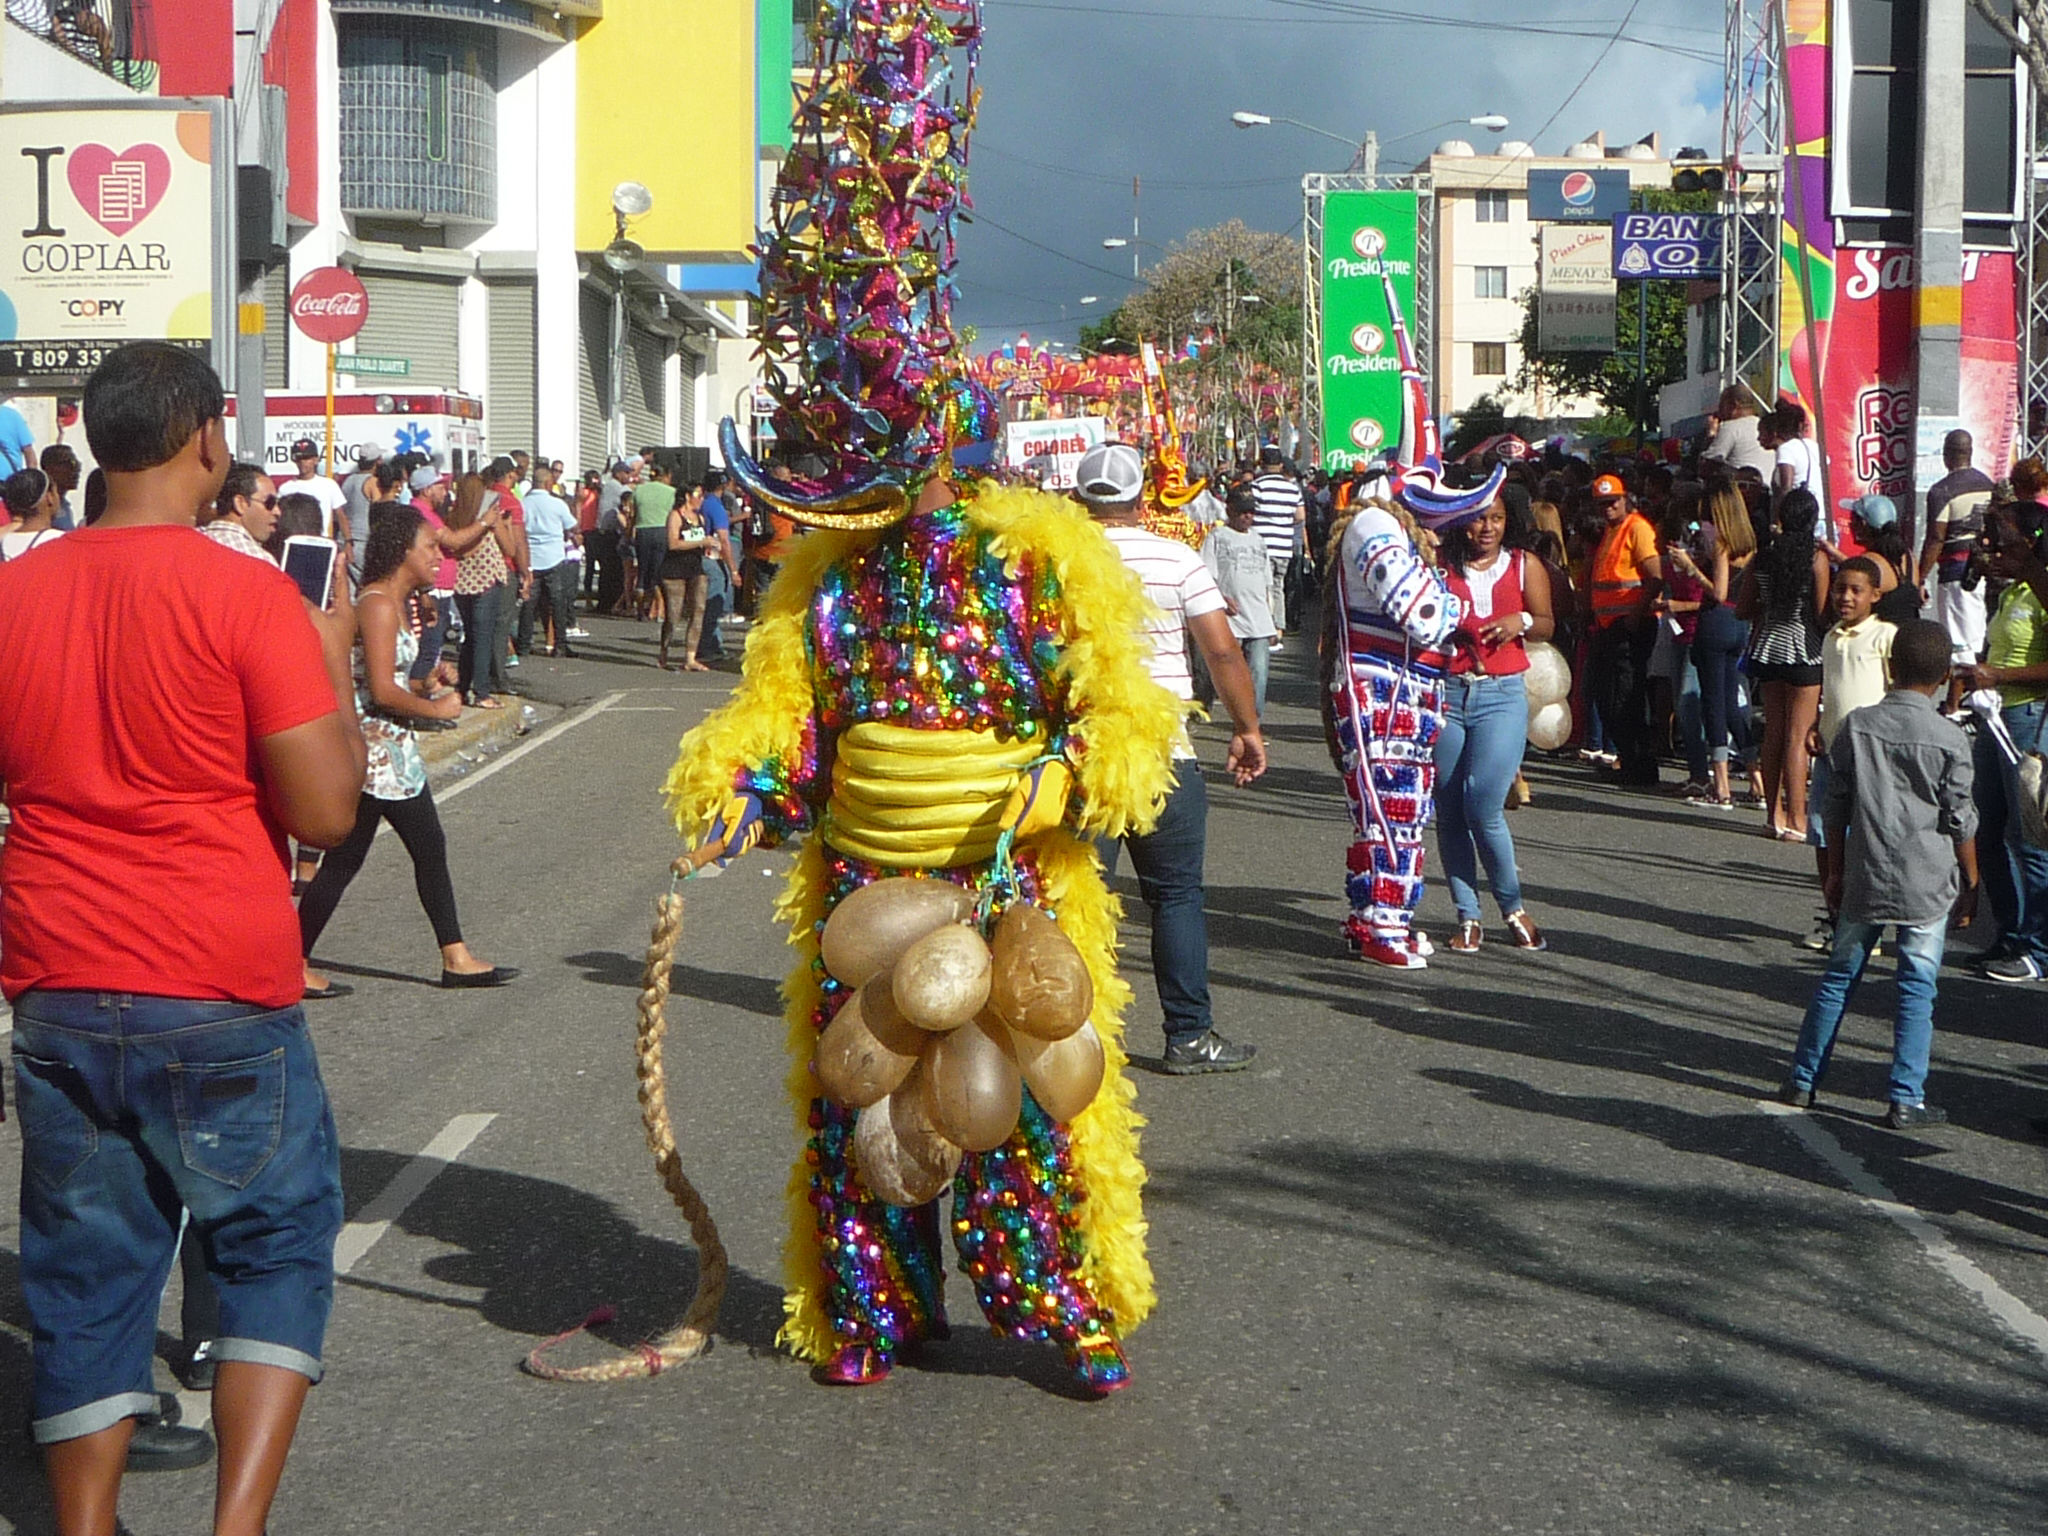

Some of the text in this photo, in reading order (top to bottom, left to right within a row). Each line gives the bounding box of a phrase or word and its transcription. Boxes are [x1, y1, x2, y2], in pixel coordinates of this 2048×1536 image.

[1563, 206, 1594, 216] pepsi
[22, 244, 171, 273] COPIAR
[1550, 267, 1610, 279] MENAY'S
[68, 299, 125, 317] COPY
[14, 351, 25, 367] T
[32, 350, 69, 367] 809
[1327, 353, 1403, 376] Presiden
[1023, 438, 1087, 457] COLORES
